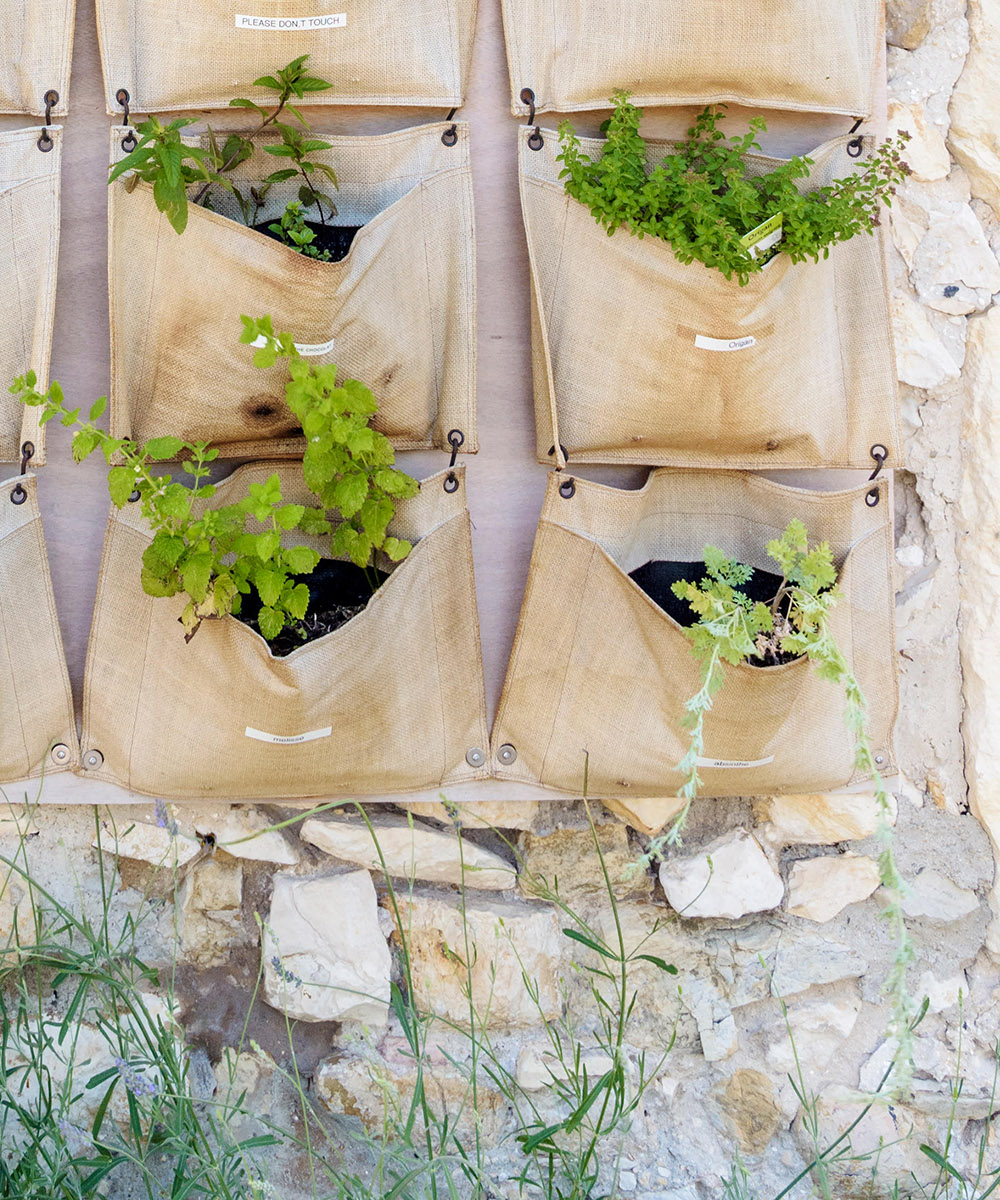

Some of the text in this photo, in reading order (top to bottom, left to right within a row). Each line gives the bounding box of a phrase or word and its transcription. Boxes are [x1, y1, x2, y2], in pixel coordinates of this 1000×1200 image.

[242, 17, 276, 28] PLEASE
[309, 17, 340, 27] TOUCH
[748, 223, 772, 241] Origan
[728, 338, 754, 349] Origan
